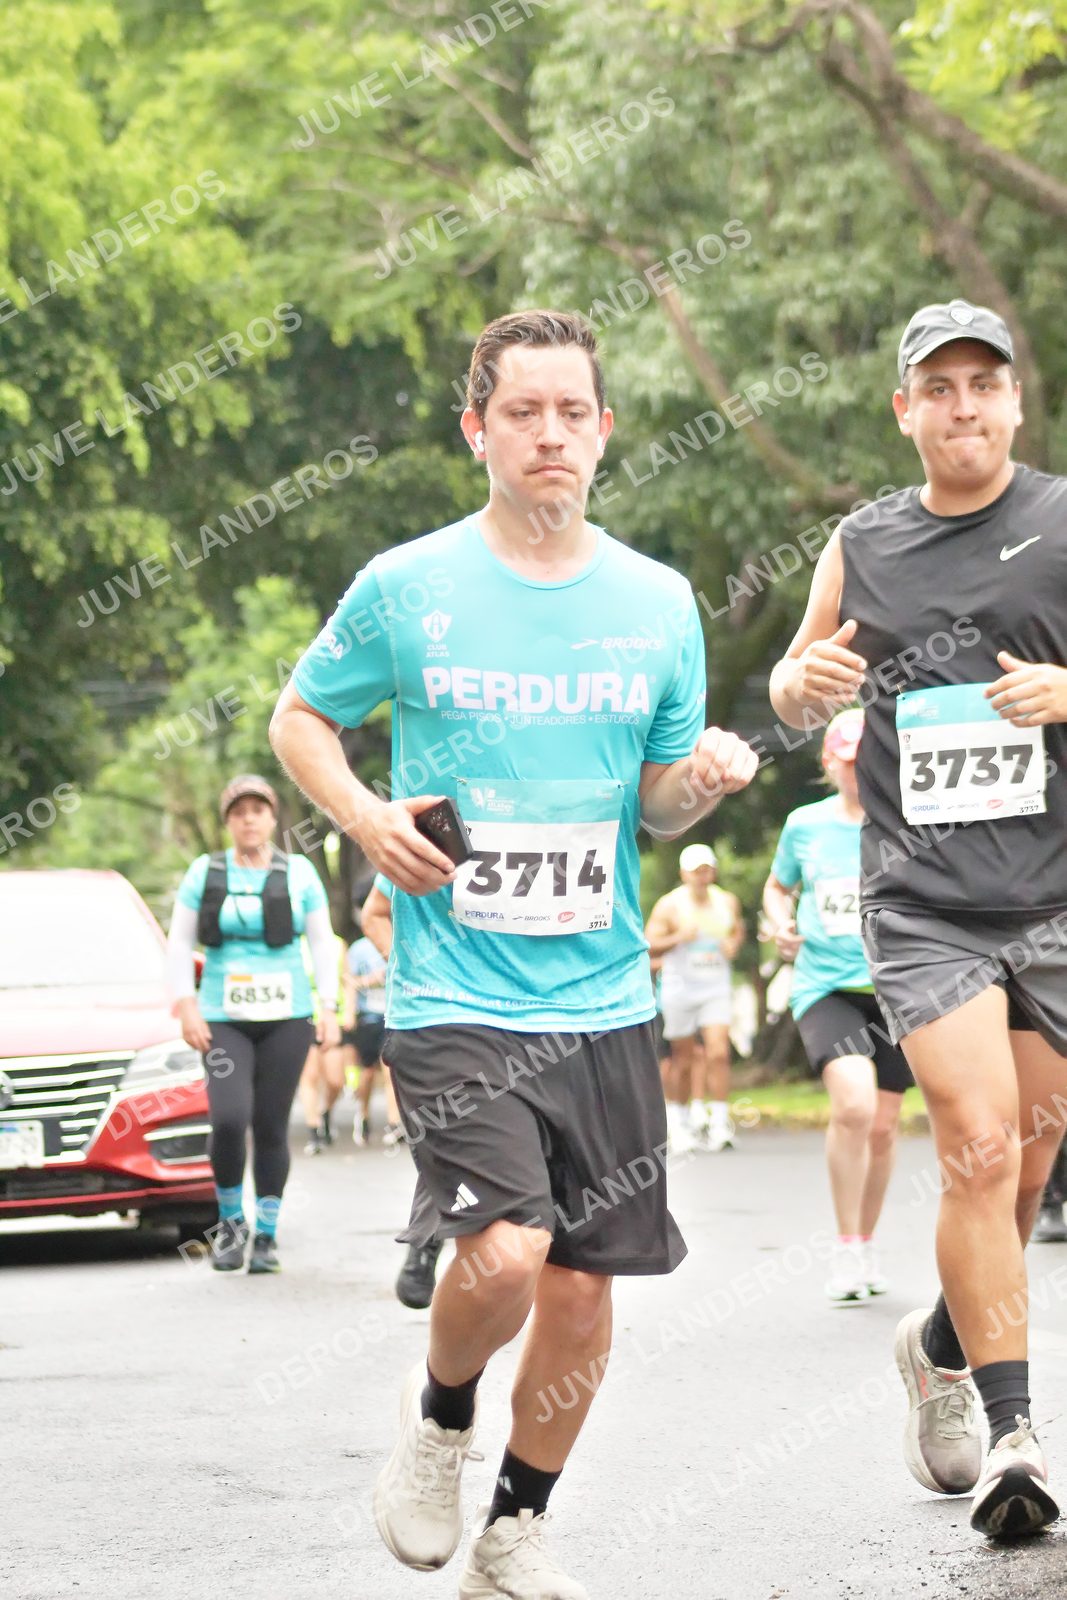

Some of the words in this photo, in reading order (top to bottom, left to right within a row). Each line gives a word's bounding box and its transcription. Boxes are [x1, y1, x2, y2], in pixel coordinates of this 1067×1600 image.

[427, 643, 447, 651] CLUB
[600, 636, 661, 652] BROOKS
[426, 650, 450, 659] ATLAS
[422, 667, 649, 715] PERDURA
[441, 710, 465, 720] PEGA
[469, 711, 502, 722] PISOS
[510, 714, 587, 727] JUNTEADORES
[910, 744, 1034, 792] 3737
[1018, 804, 1039, 813] 3737
[466, 849, 607, 897] 3714
[822, 894, 858, 914] 42
[465, 910, 505, 921] PERDURA
[524, 914, 551, 922] BROOKS
[588, 920, 608, 929] 3714
[231, 985, 286, 1004] 6834
